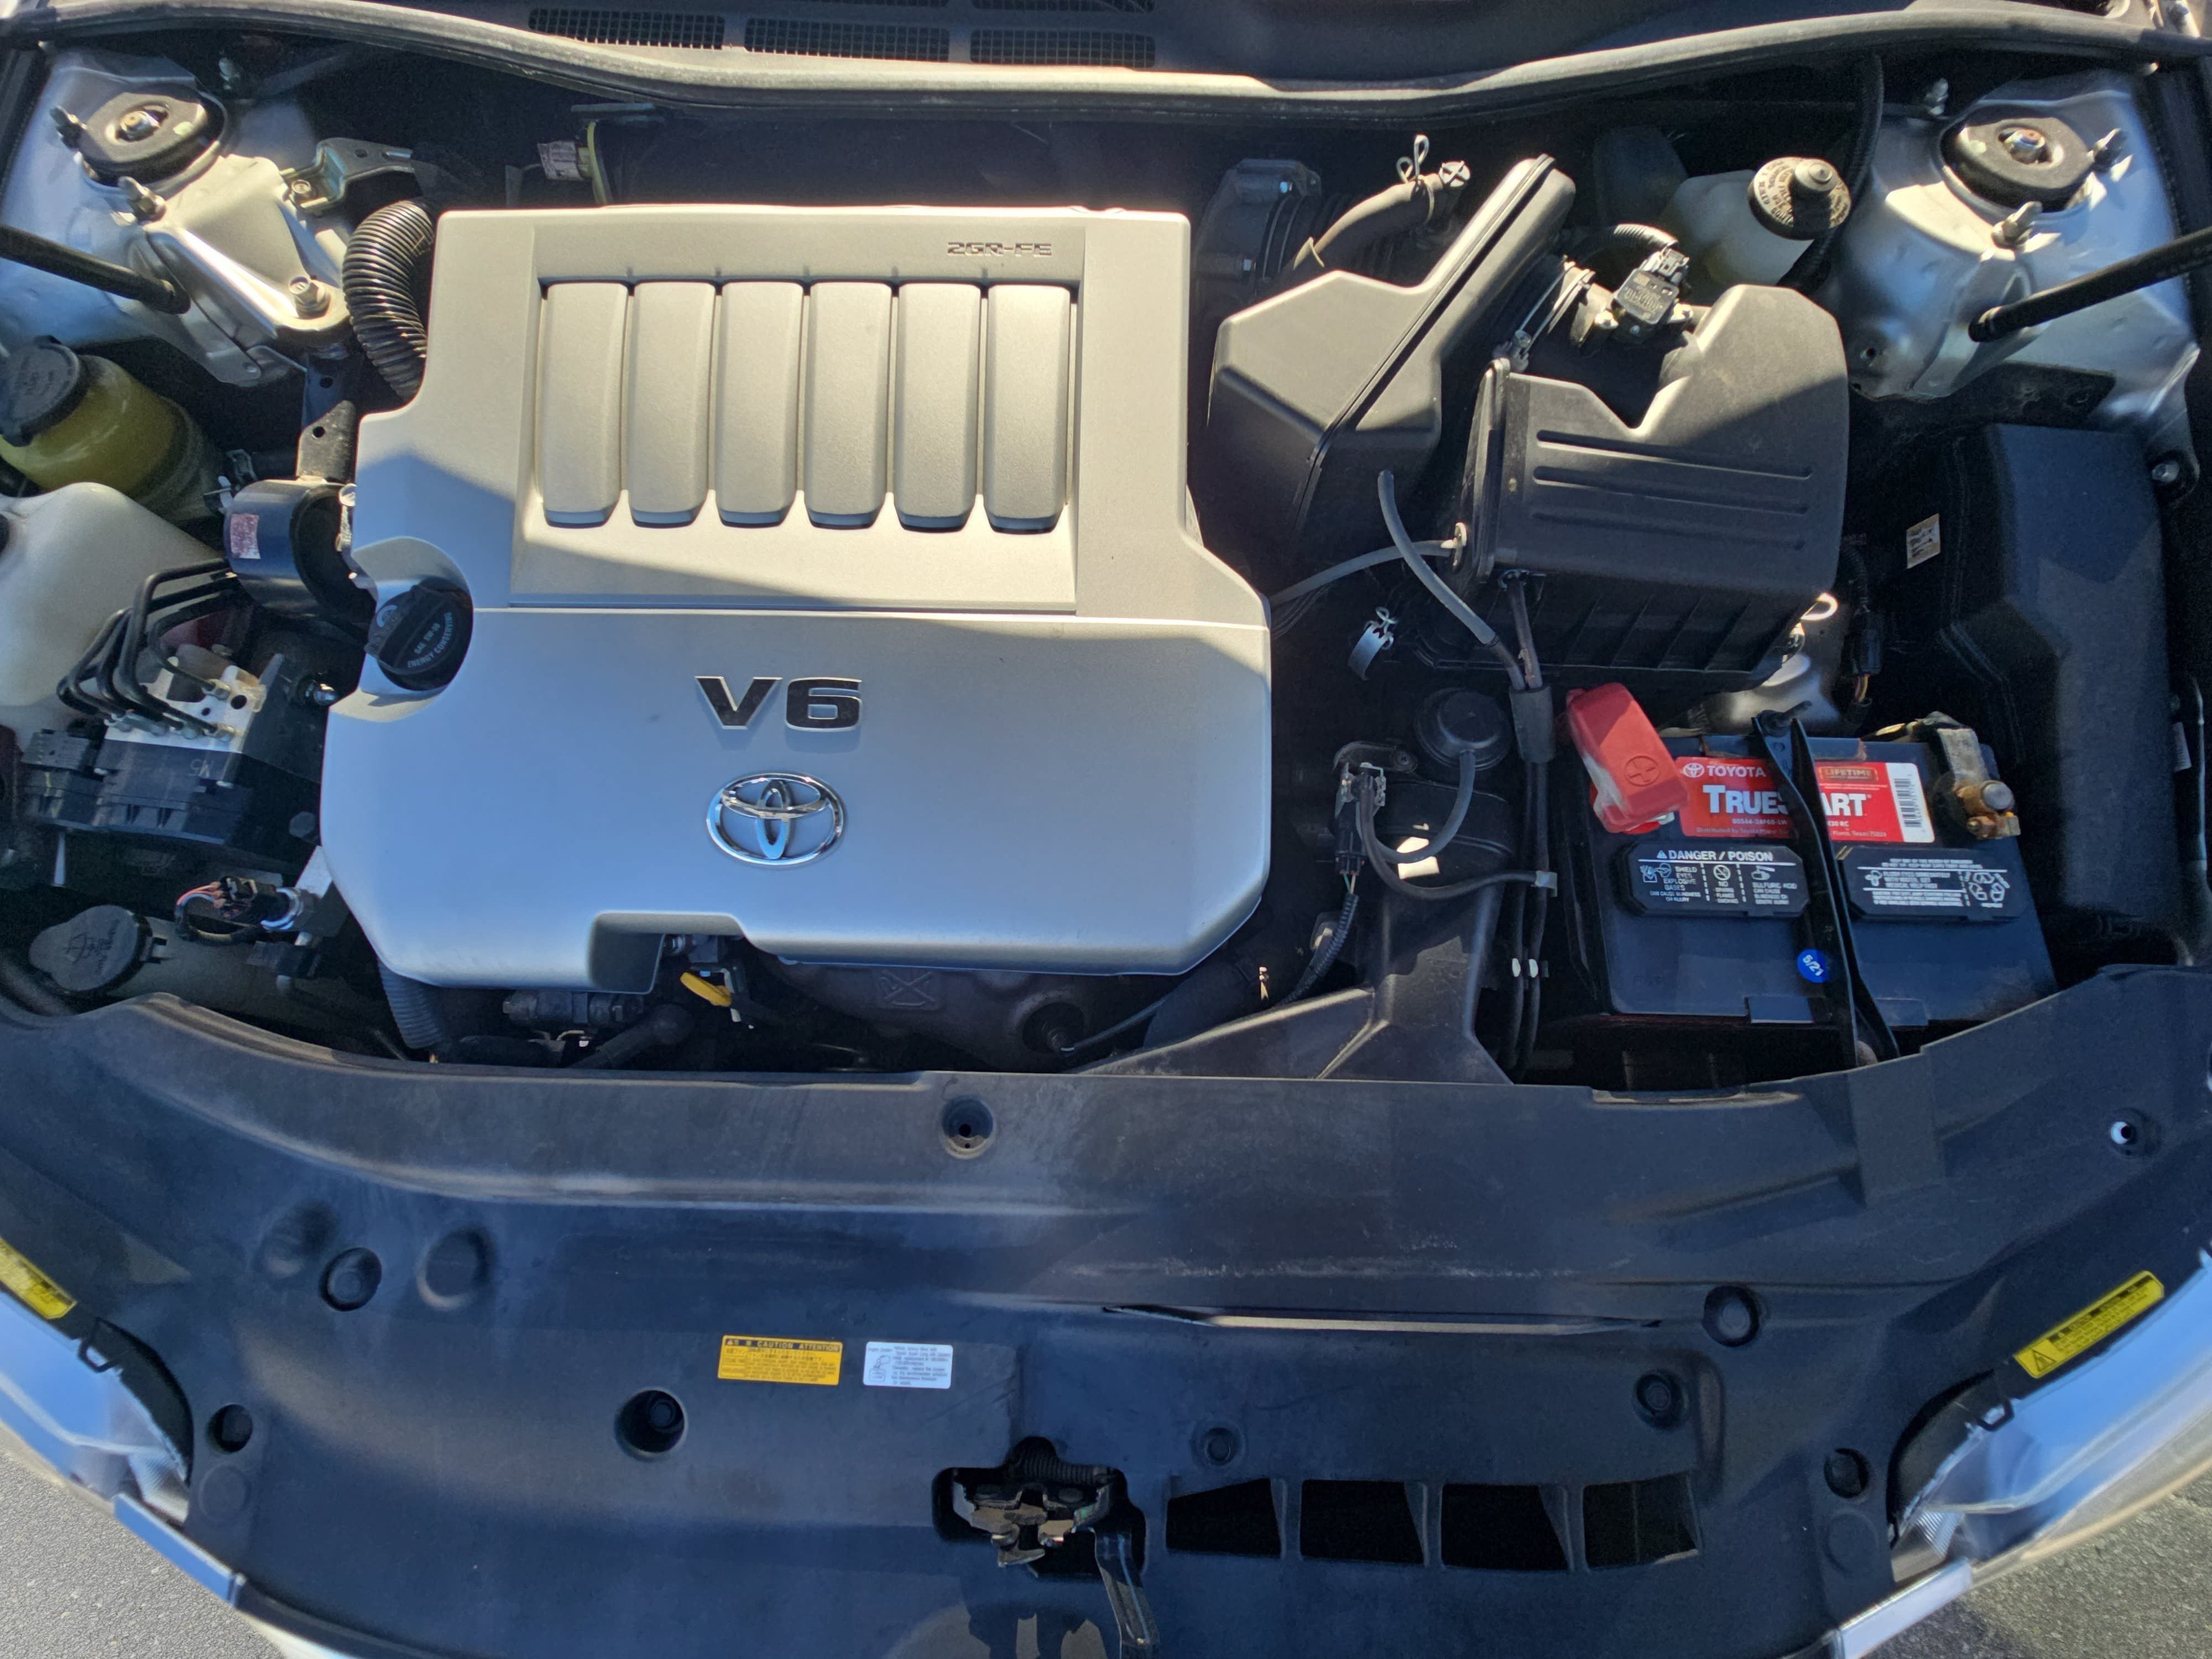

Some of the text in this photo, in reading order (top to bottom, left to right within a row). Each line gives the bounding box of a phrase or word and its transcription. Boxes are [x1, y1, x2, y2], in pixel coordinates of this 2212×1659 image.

[947, 242, 1052, 257] 2GR-FE
[407, 651, 434, 668] ENERGY
[695, 676, 862, 732] V6
[1707, 765, 1766, 778] TOYOTA
[1668, 850, 1774, 862] DANGER / POISON
[757, 1340, 794, 1349] CAUTION
[799, 1342, 839, 1352] ATTENTION
